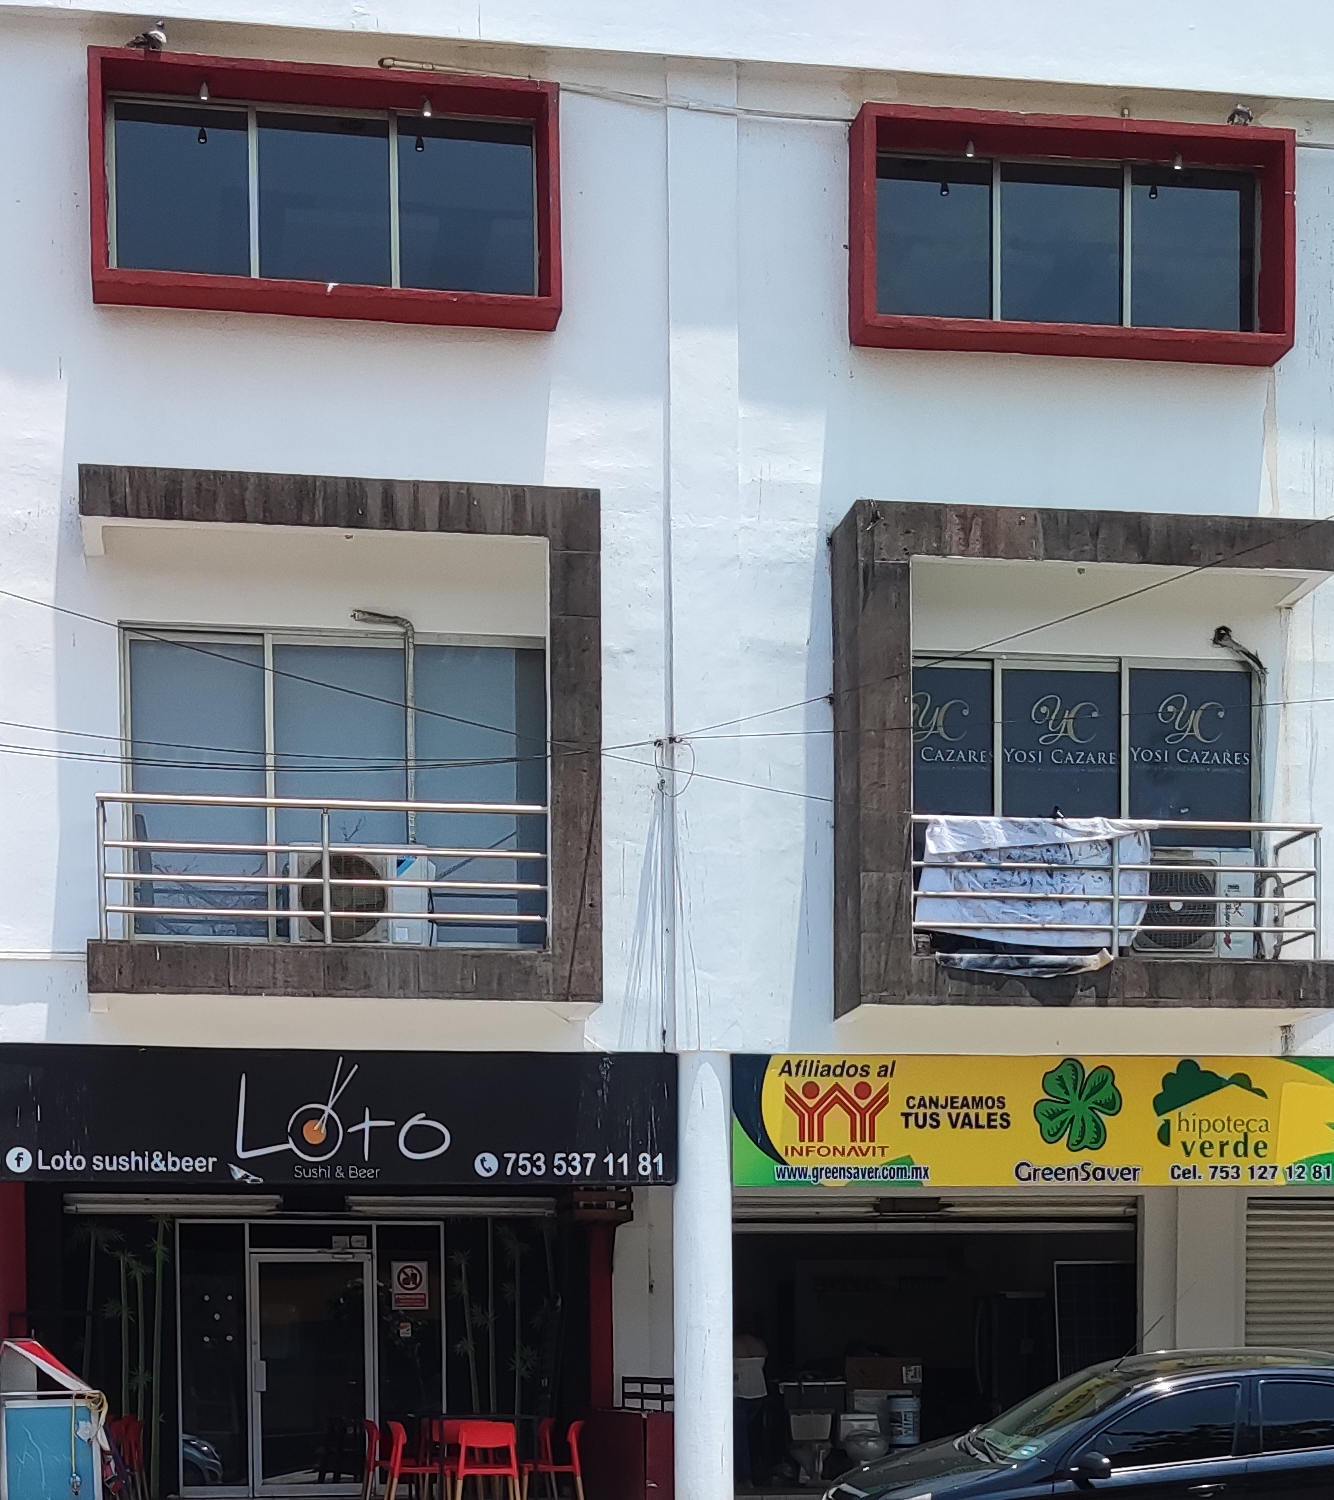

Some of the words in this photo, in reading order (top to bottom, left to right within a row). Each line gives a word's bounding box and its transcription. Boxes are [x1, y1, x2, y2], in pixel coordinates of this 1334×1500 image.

[1003, 748, 1042, 764] YOSI
[1130, 747, 1168, 763] YOSI
[1176, 748, 1251, 766] CAZARES
[778, 1059, 871, 1078] Afiliados
[877, 1060, 896, 1078] al
[236, 1057, 451, 1162] Loto
[906, 1096, 1006, 1110] CANJEAMOS
[901, 1112, 941, 1130] TUS
[947, 1112, 1011, 1130] VALES
[1178, 1111, 1270, 1139] hipoteca
[785, 1146, 890, 1157] INFONAVIT
[1181, 1132, 1268, 1158] verde
[37, 1149, 87, 1172] Loto
[92, 1150, 218, 1172] sushi&beer
[503, 1152, 547, 1176] 753
[553, 1152, 597, 1176] 537
[603, 1152, 629, 1176] 11
[638, 1152, 664, 1176] 81
[294, 1164, 331, 1179] Sushi
[335, 1165, 345, 1179] &
[348, 1165, 381, 1179] Beer
[775, 1165, 930, 1183] www.greensaver.com.mx
[1014, 1161, 1142, 1182] GreenSaver
[1170, 1165, 1202, 1180] Cel.
[1209, 1165, 1241, 1180] 753
[1248, 1165, 1279, 1180] 127
[1286, 1166, 1305, 1180] 12
[1312, 1166, 1332, 1180] 81
